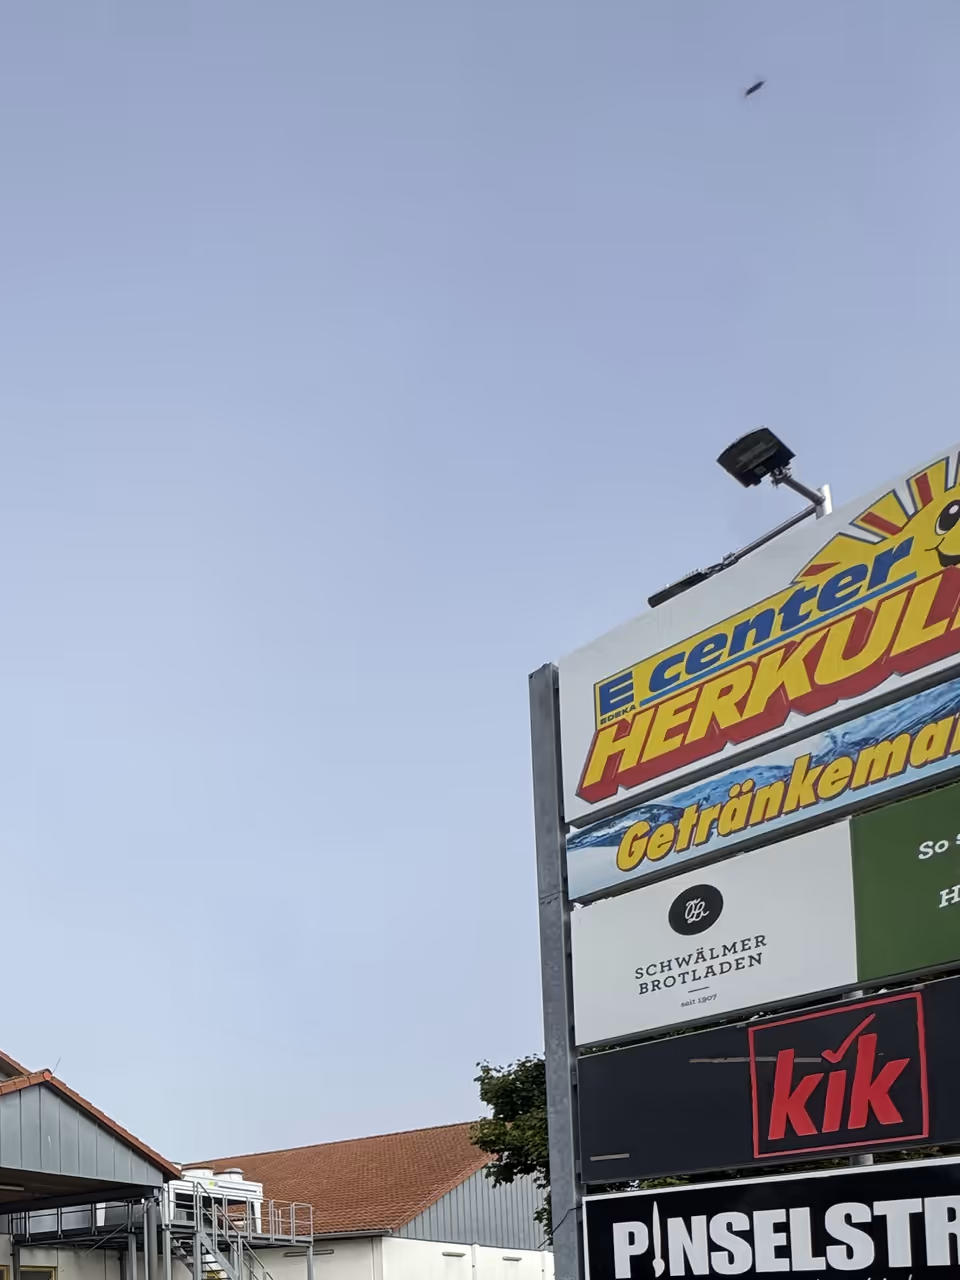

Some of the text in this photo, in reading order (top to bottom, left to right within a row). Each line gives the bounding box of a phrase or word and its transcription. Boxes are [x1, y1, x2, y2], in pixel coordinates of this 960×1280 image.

[648, 535, 915, 694] center
[580, 569, 960, 792] HERKUL
[599, 704, 637, 726] EDEKA
[918, 839, 950, 860] So
[634, 933, 768, 980] SCHWÄLMER
[638, 951, 763, 996] BROTLADEN
[680, 993, 718, 1008] seit 1907
